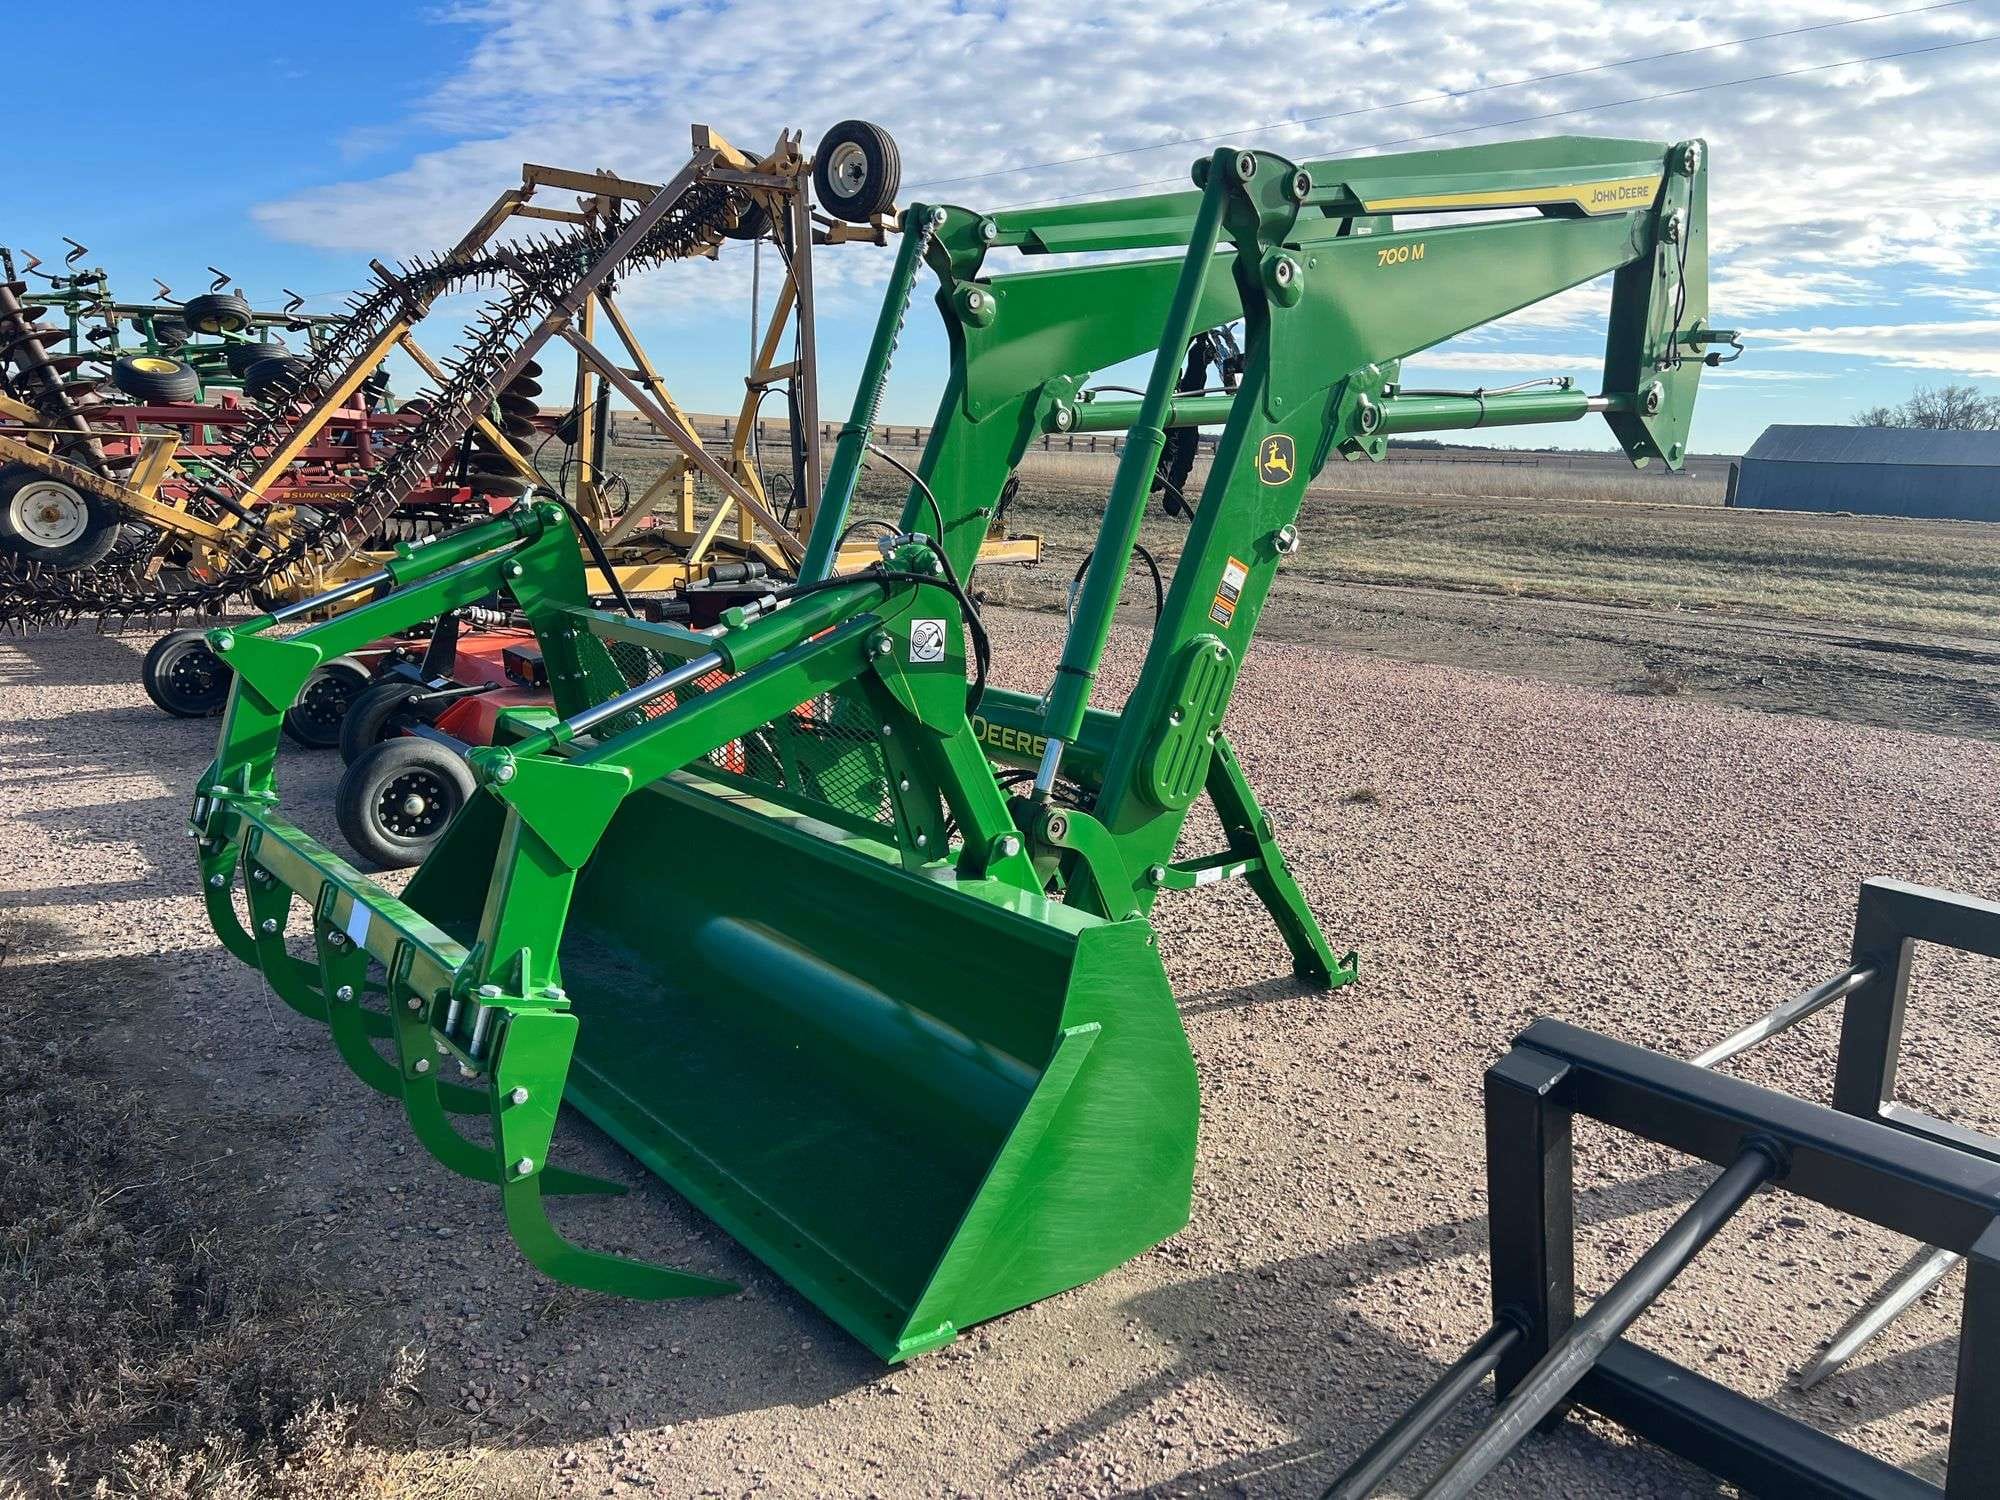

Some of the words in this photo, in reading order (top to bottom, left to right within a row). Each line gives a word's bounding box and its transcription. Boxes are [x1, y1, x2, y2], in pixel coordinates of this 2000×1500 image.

[1591, 189, 1617, 203] JOHN
[1618, 185, 1649, 200] DEERE
[1377, 246, 1409, 267] 700
[1411, 242, 1425, 261] M
[971, 714, 1048, 758] DEERE
